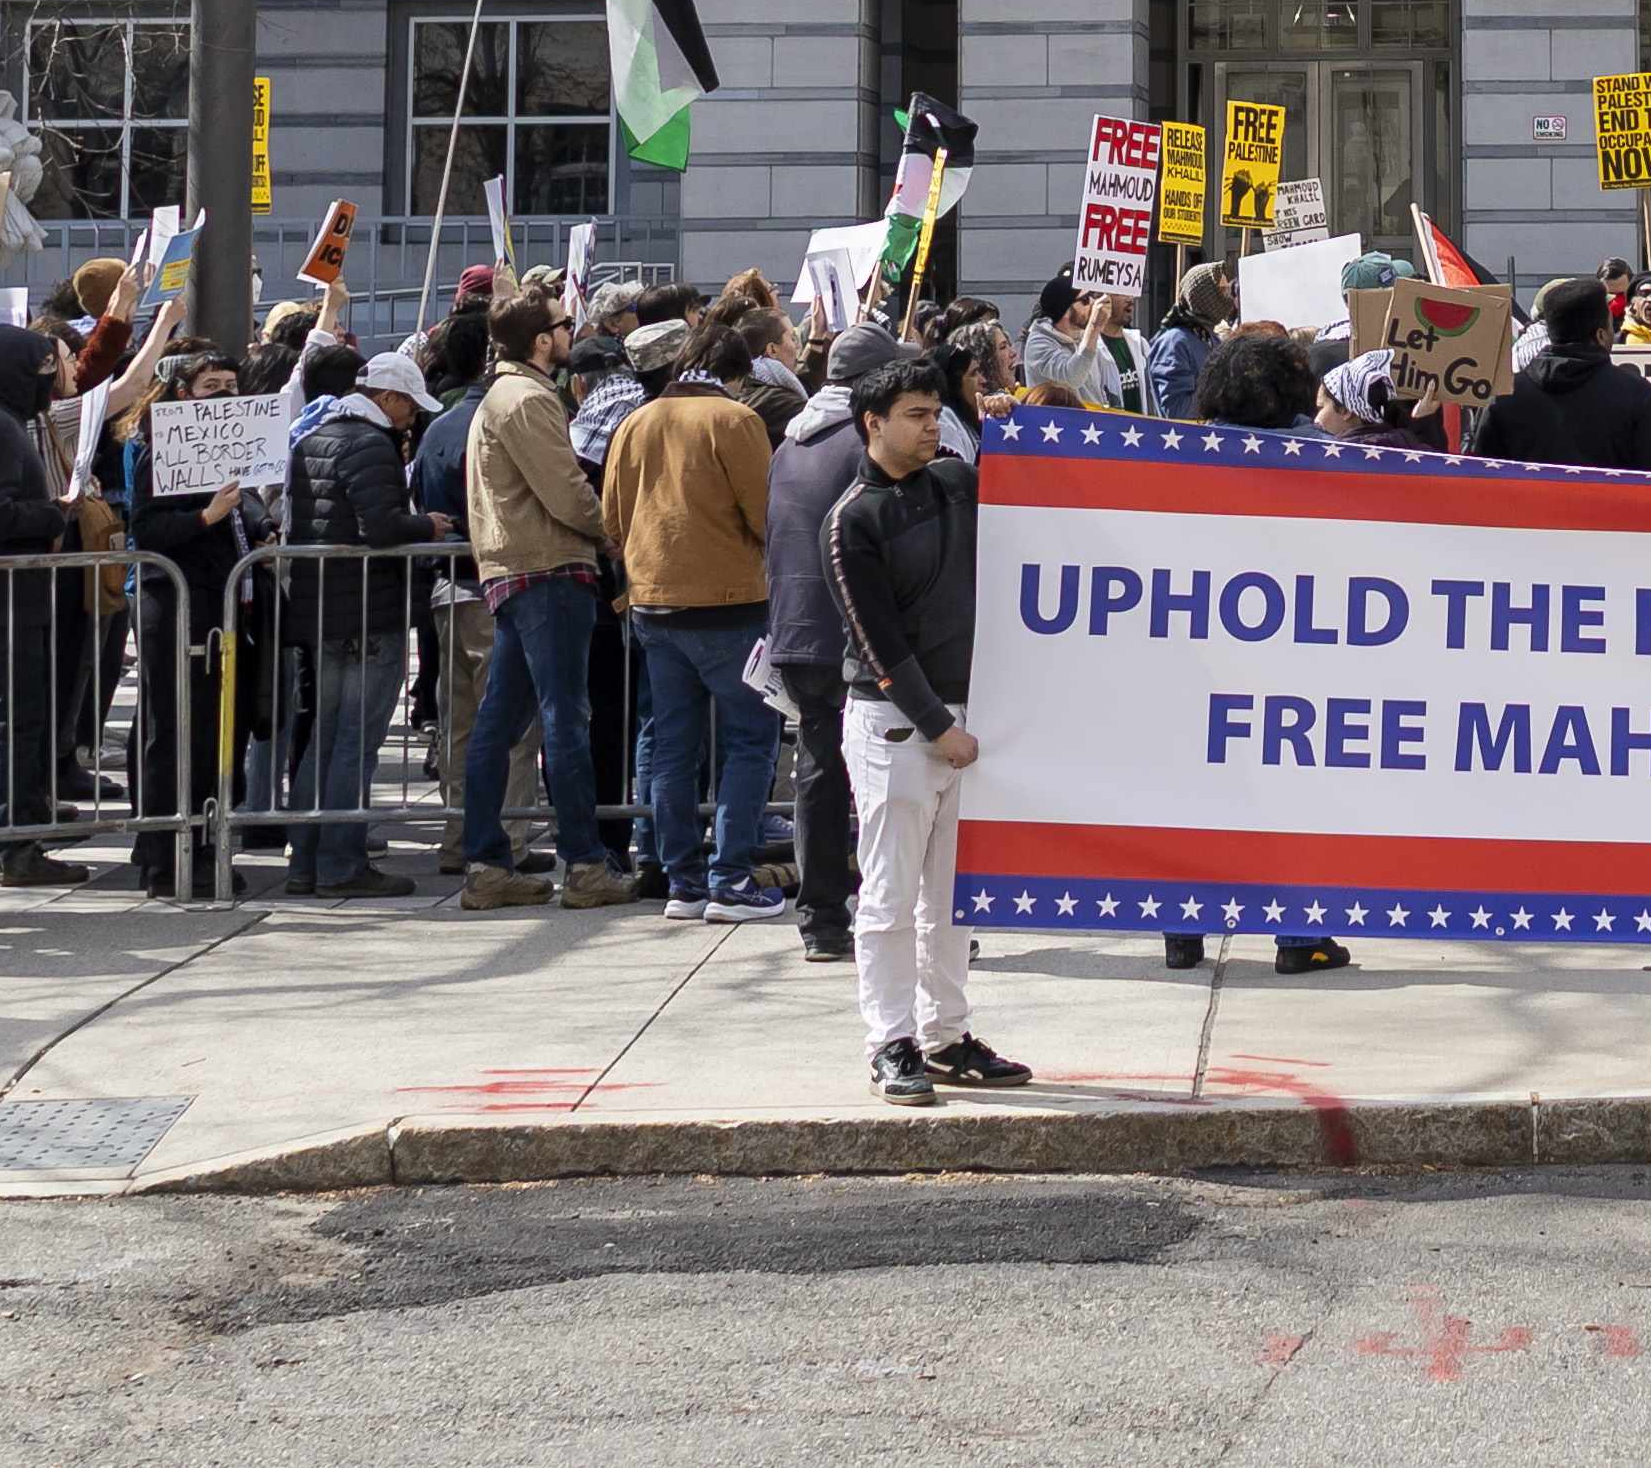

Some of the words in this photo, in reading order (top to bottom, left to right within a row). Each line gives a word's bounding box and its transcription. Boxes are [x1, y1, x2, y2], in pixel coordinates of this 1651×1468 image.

[1596, 76, 1640, 93] STAND
[1233, 105, 1279, 145] FREE
[1536, 119, 1550, 130] NO
[1599, 109, 1639, 133] END
[1092, 116, 1160, 170] FREE
[1167, 128, 1203, 152] RELEASE
[1167, 149, 1203, 169] MAHMOUD
[1228, 141, 1279, 164] PALESTINE
[1089, 170, 1154, 202] MAHMOUD
[1277, 182, 1319, 196] MAHMOUD
[1165, 189, 1191, 208] HANDS
[1287, 192, 1320, 205] KHALIL
[1163, 207, 1176, 219] OUR
[1269, 217, 1300, 232] REEN
[1302, 212, 1325, 226] CARD
[1082, 203, 1151, 255] FREE
[1267, 233, 1292, 246] SHOW
[1077, 256, 1142, 289] RUMEYSA
[1388, 318, 1440, 353] Let
[1391, 352, 1439, 393] Him
[1444, 356, 1491, 400] Go
[155, 406, 184, 417] FROM
[192, 399, 280, 422] PALESTINE
[167, 422, 244, 445] MEXICO
[154, 449, 189, 468] ALL
[191, 437, 267, 464] BORDER
[156, 464, 225, 493] WALLS
[229, 465, 251, 477] HAVE
[1019, 563, 1410, 646] UPHOLD
[1431, 579, 1607, 655] THE
[1206, 693, 1427, 771] FREE
